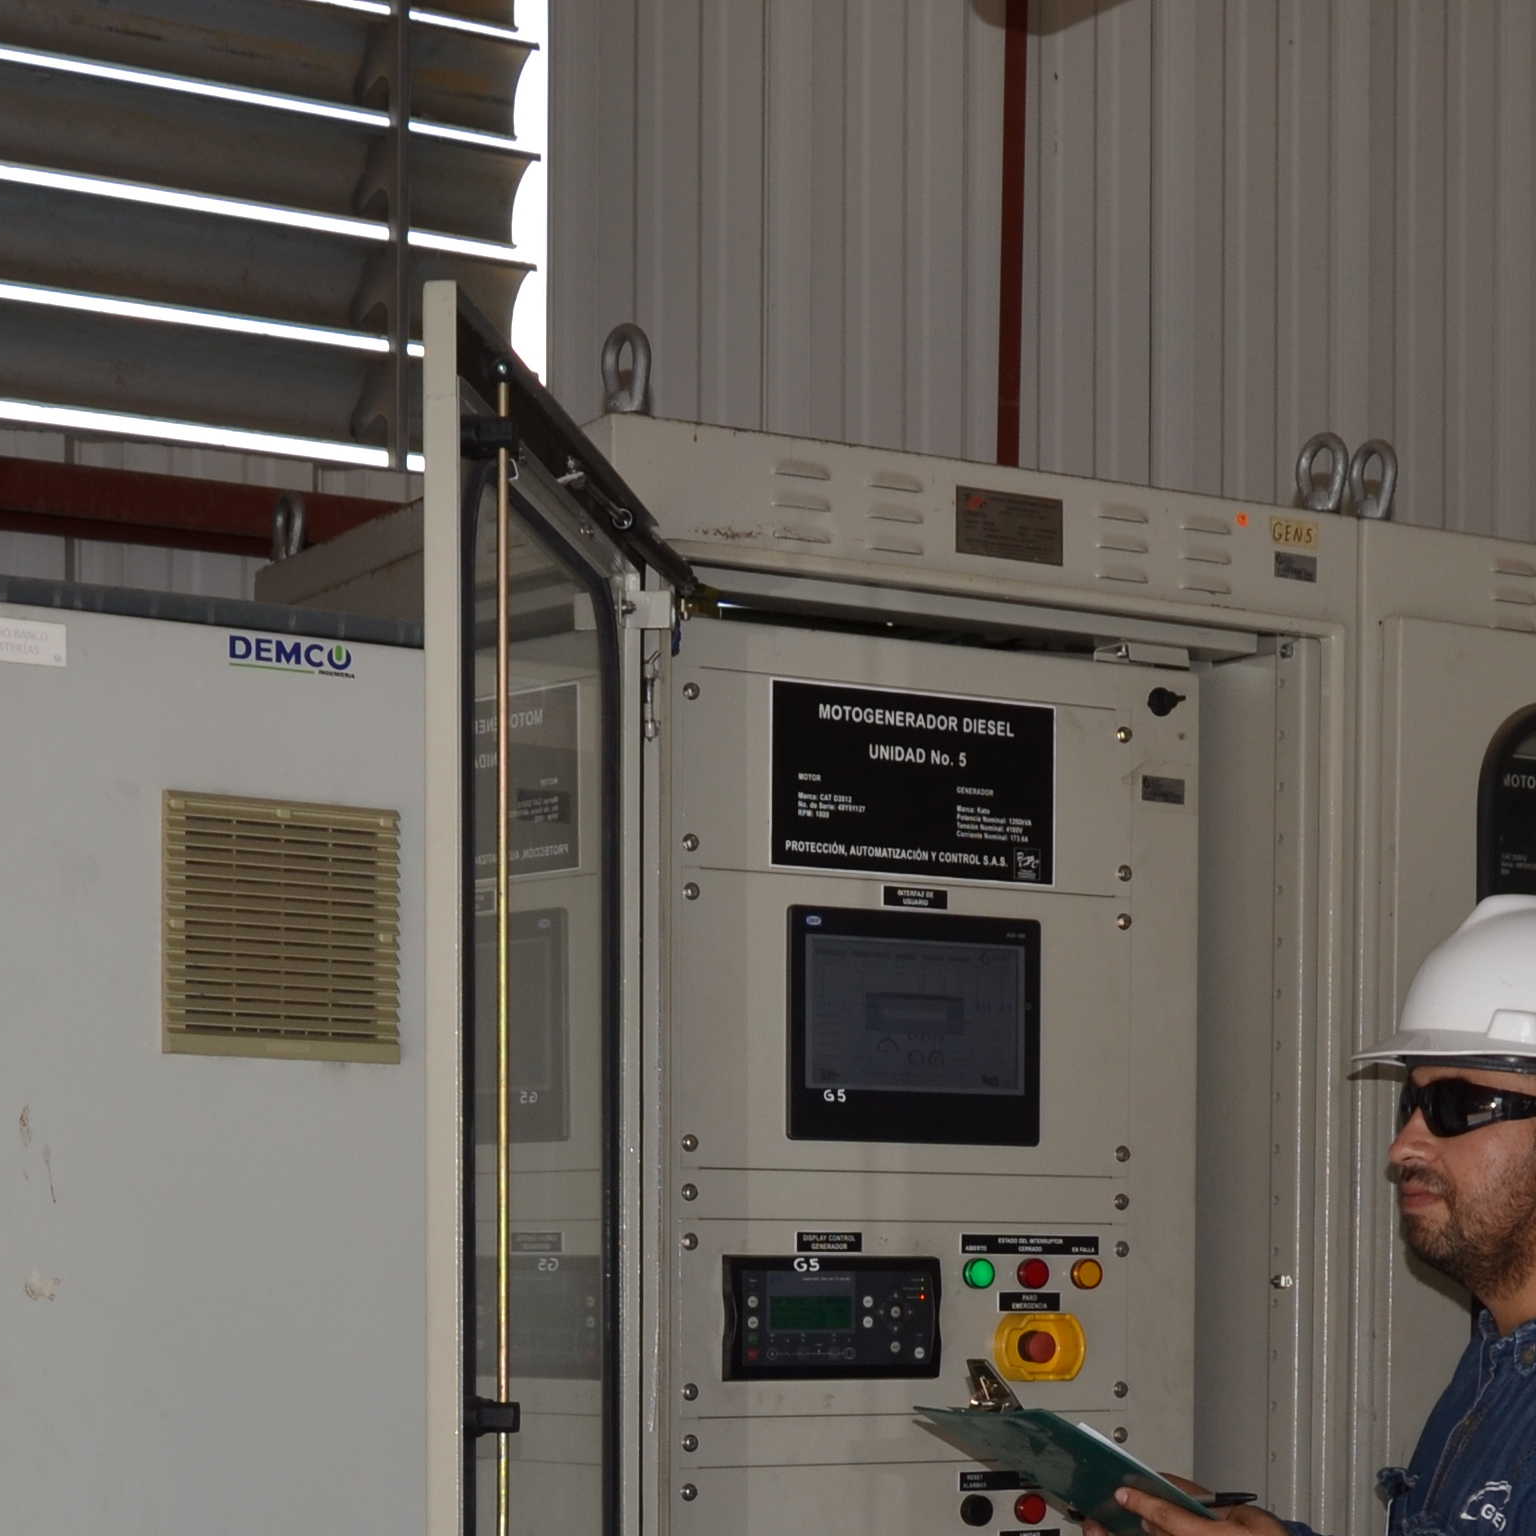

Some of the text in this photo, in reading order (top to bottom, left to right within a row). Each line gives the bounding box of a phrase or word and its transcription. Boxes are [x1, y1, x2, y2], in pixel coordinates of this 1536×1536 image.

[14, 629, 49, 642] BANCO
[229, 635, 352, 670] DEMCO
[819, 704, 1015, 737] MOTOGENERADOR DIESEL
[869, 744, 967, 767] UNIDAD No. 5
[798, 773, 822, 782] MOTOR
[956, 786, 994, 797] GENERADOR
[785, 839, 848, 857] PROTECCIÓN,
[850, 845, 929, 862] AUTOMATIZACIÓN
[930, 850, 937, 862] Y
[939, 851, 981, 865] CONTROL
[983, 855, 1009, 868] S.A.S.
[897, 889, 934, 899] INTERFAZ DE
[802, 1234, 856, 1242] DISPLAY CONTROL
[1018, 1245, 1043, 1253] CERRADO
[1022, 1294, 1038, 1302] PARO
[1011, 1302, 1048, 1310] EMERGENCIA
